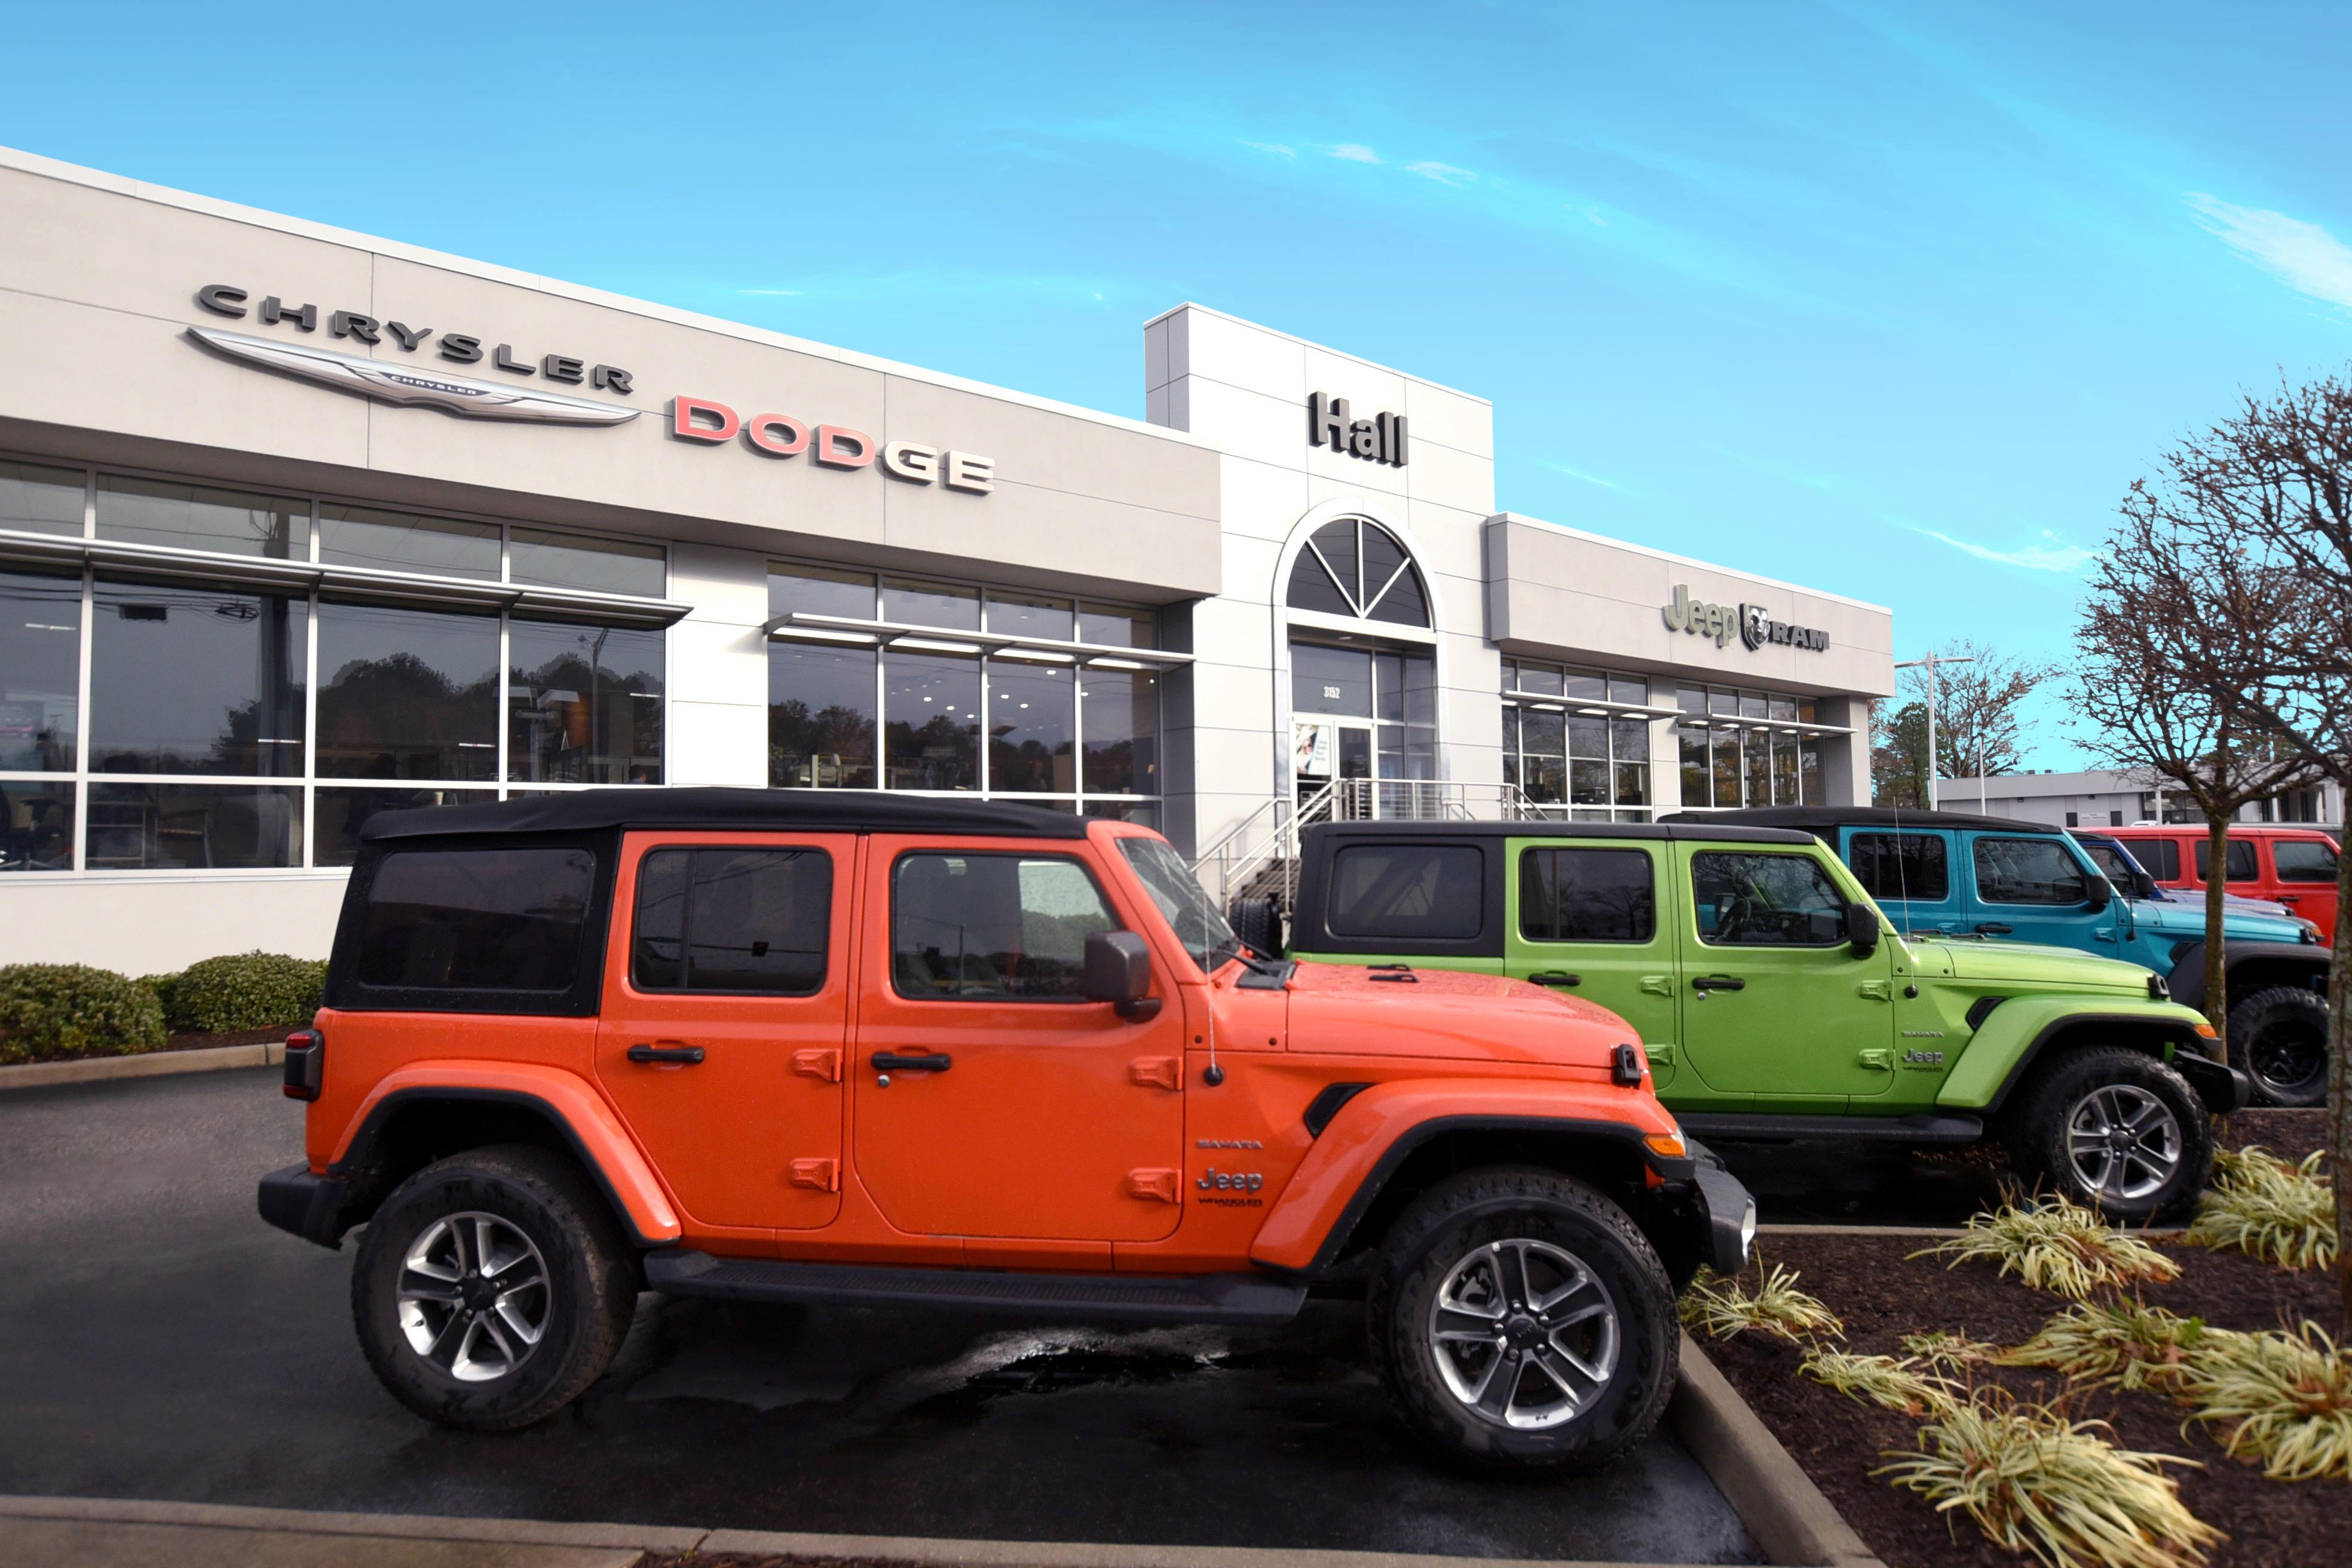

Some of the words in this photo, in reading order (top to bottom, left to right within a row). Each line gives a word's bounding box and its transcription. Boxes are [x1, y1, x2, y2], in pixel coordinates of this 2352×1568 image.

[198, 284, 634, 394] CHRYSLER
[391, 376, 477, 395] CHRYSLER
[673, 394, 995, 494] DODGE
[1310, 391, 1408, 467] Hall
[1663, 584, 1738, 648] Jeep
[1769, 621, 1830, 653] RAM
[1323, 686, 1340, 699] 3152
[1902, 1048, 1944, 1065] Jeep
[1198, 1139, 1263, 1149] SAHARA
[1197, 1167, 1263, 1195] Jeep
